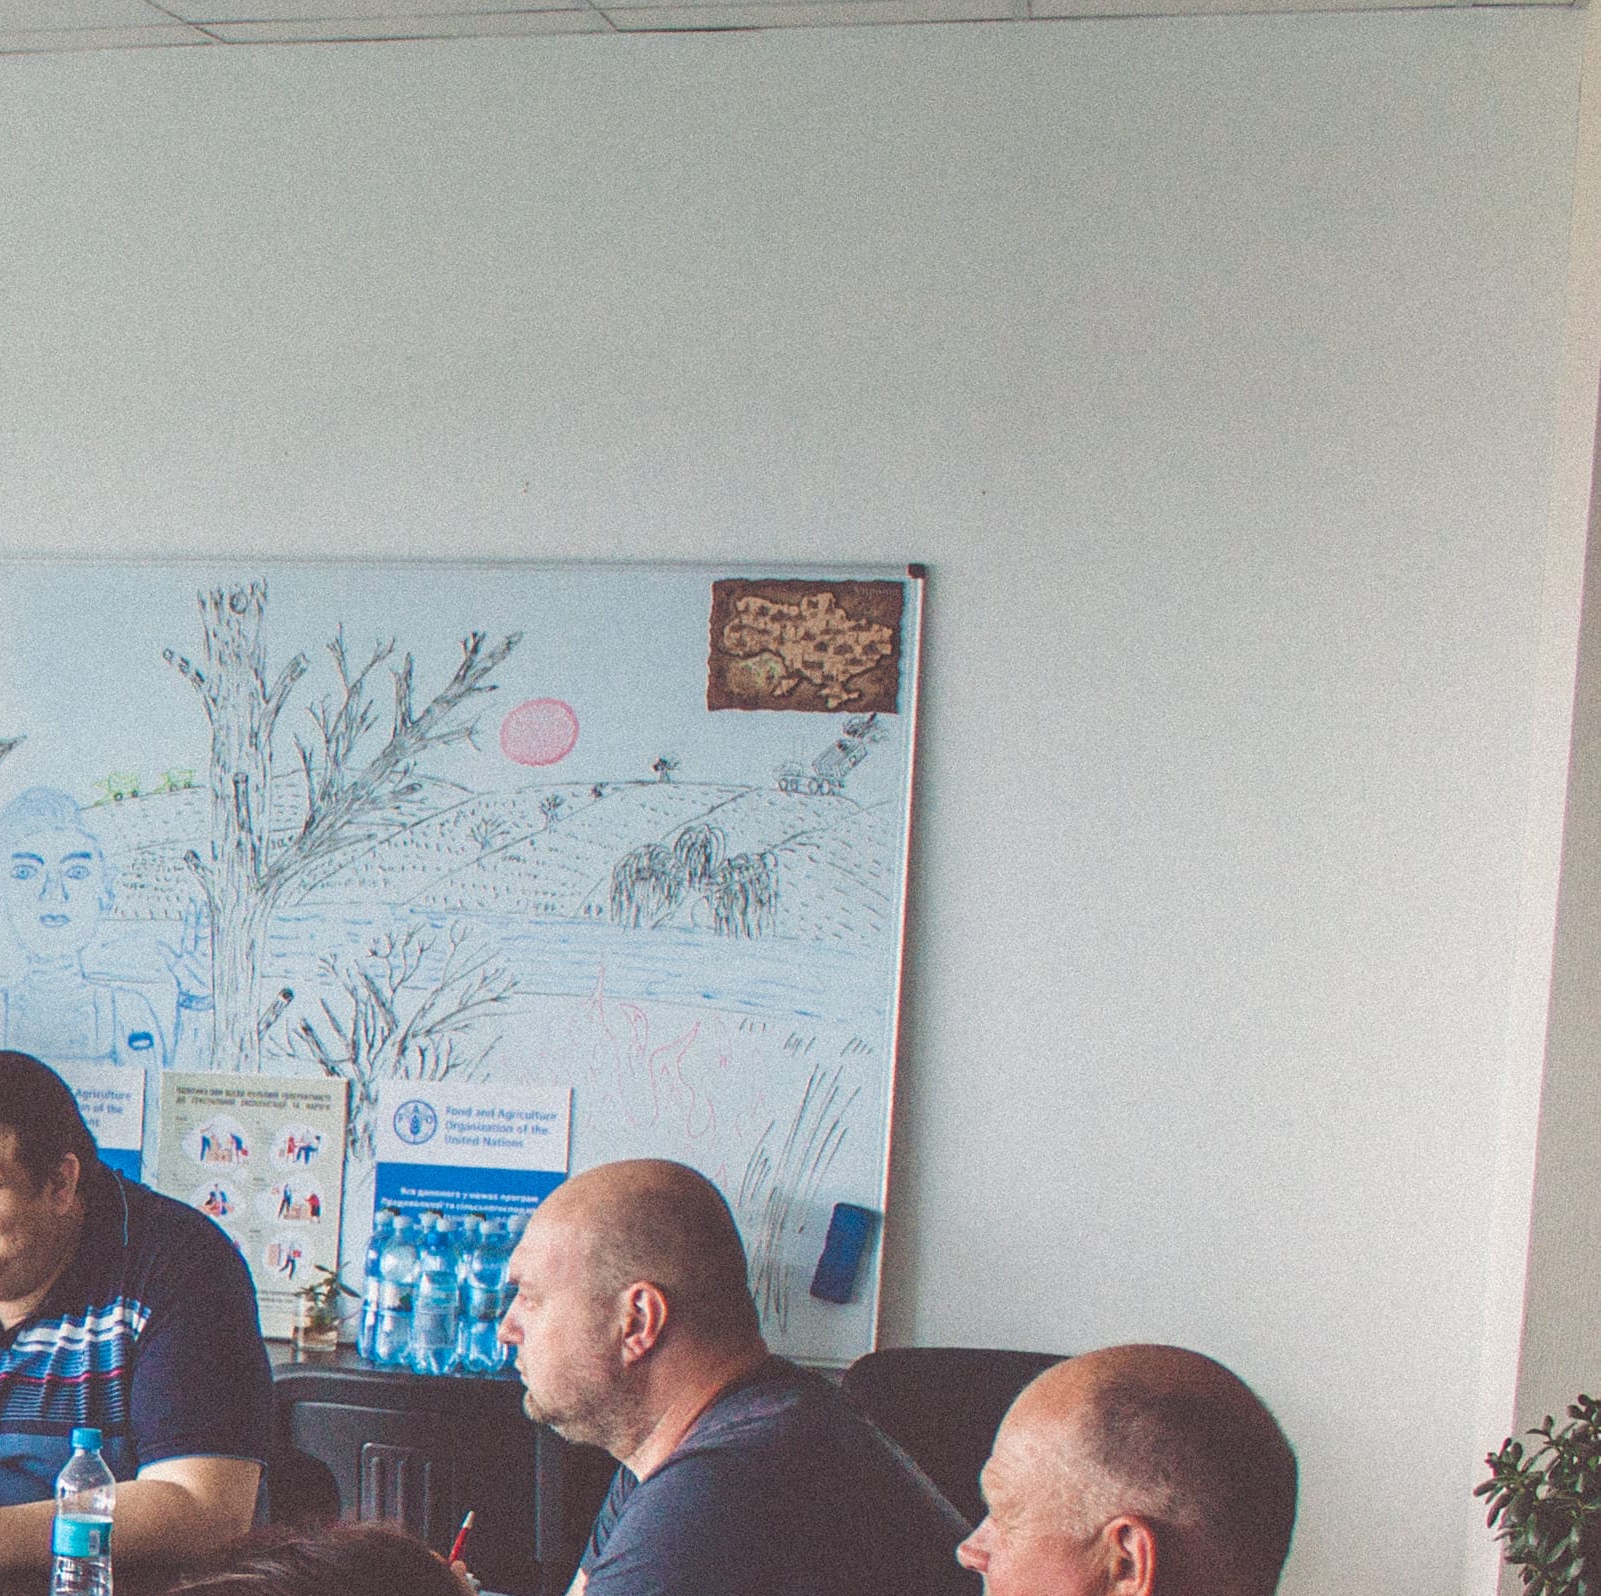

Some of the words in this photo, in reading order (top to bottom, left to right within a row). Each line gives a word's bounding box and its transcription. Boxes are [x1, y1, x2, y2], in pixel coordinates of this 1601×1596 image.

[498, 1108, 557, 1120] Agriculture
[516, 1123, 528, 1134] of
[531, 1124, 549, 1135] the
